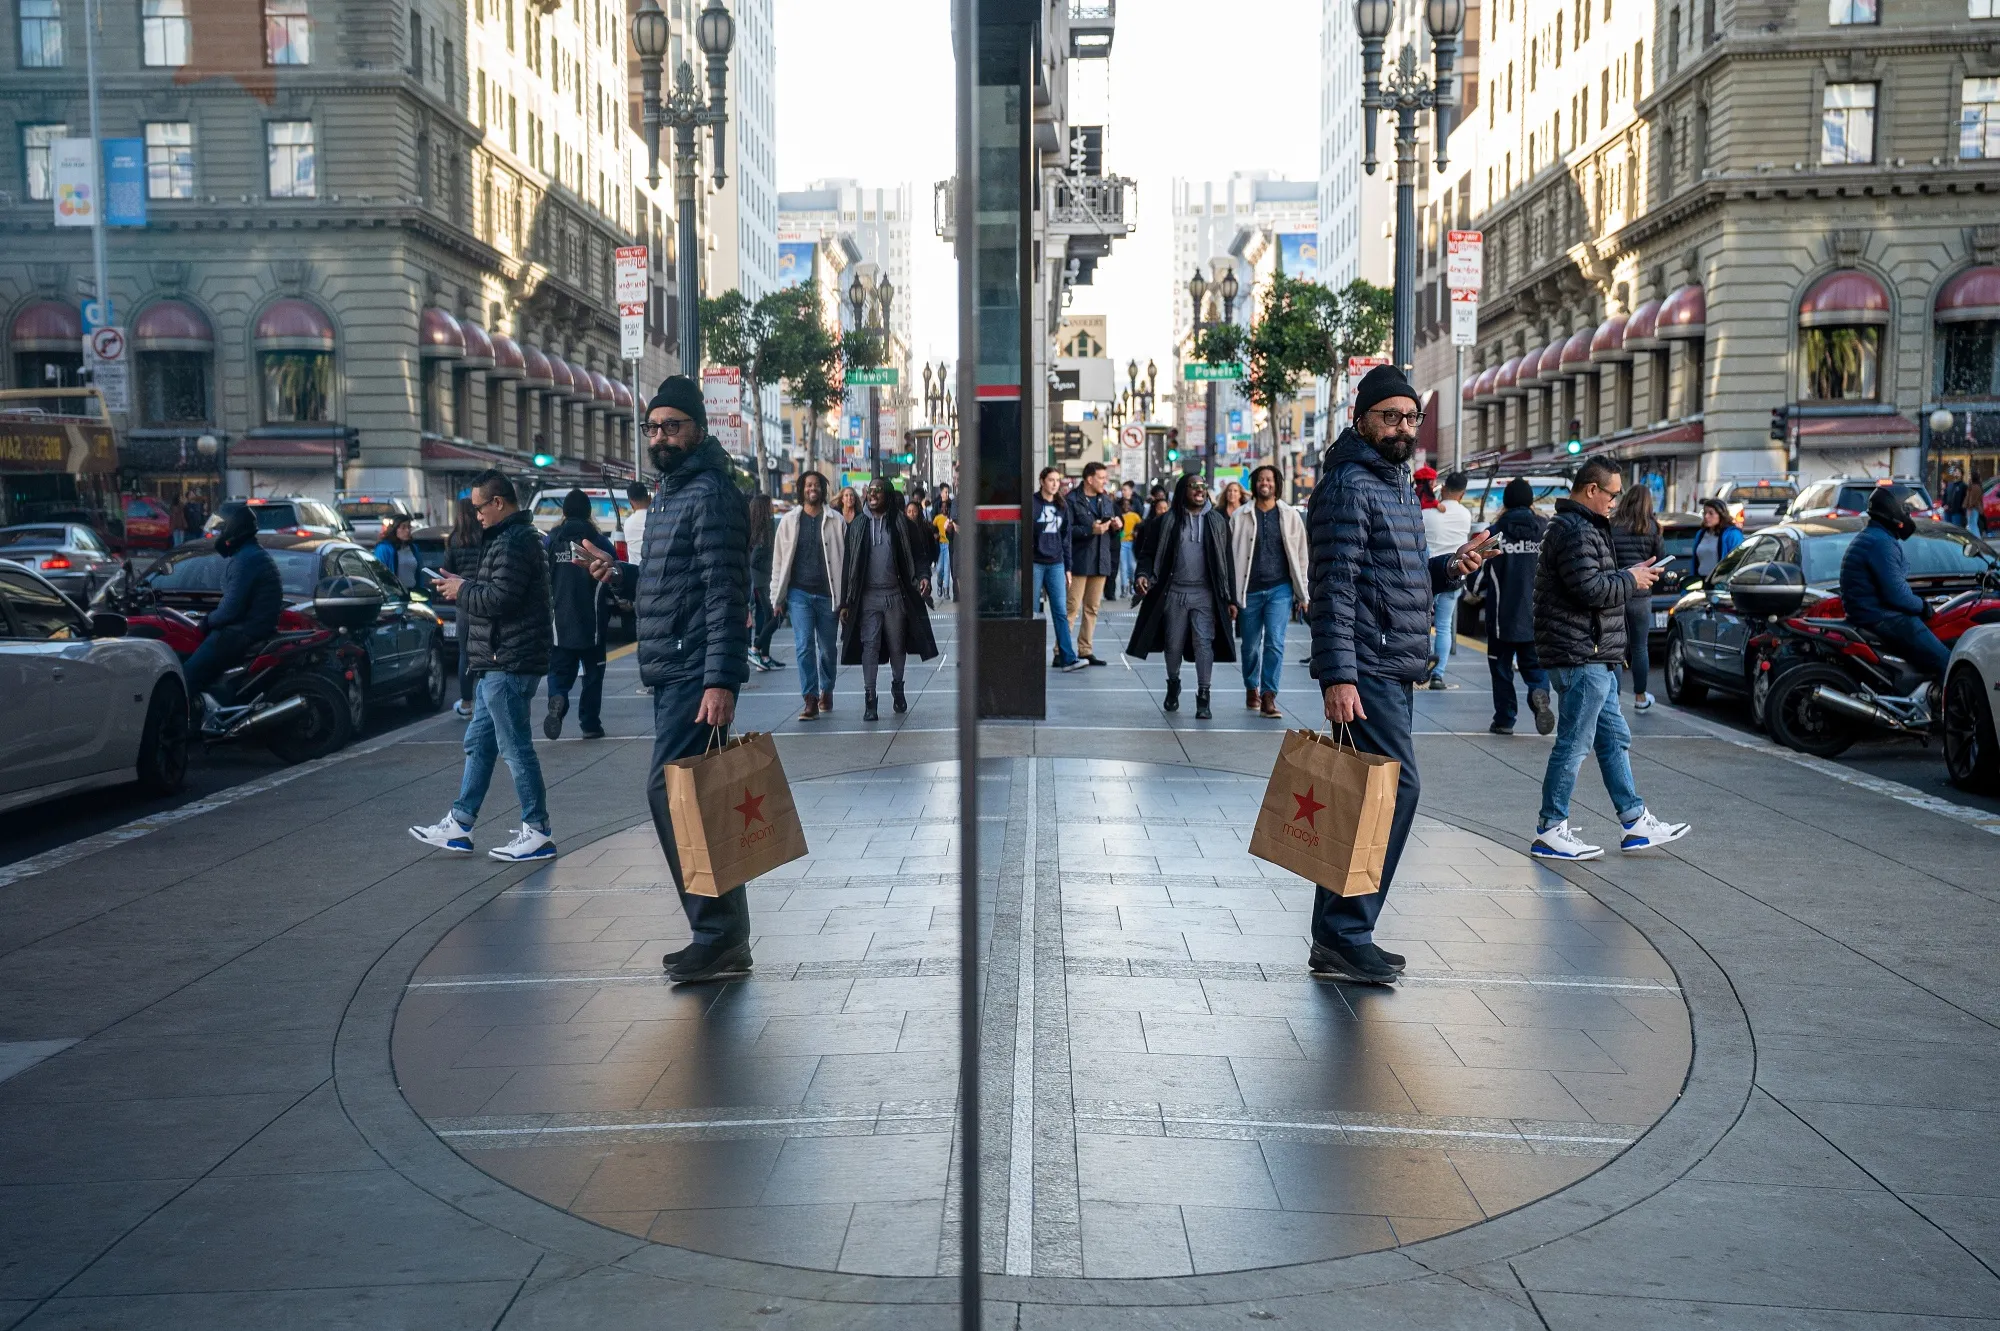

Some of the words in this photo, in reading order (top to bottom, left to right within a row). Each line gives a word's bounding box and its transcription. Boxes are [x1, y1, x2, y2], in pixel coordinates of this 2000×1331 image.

[1195, 366, 1232, 377] Powell
[1053, 382, 1076, 391] dyson
[1499, 538, 1540, 554] FedEx
